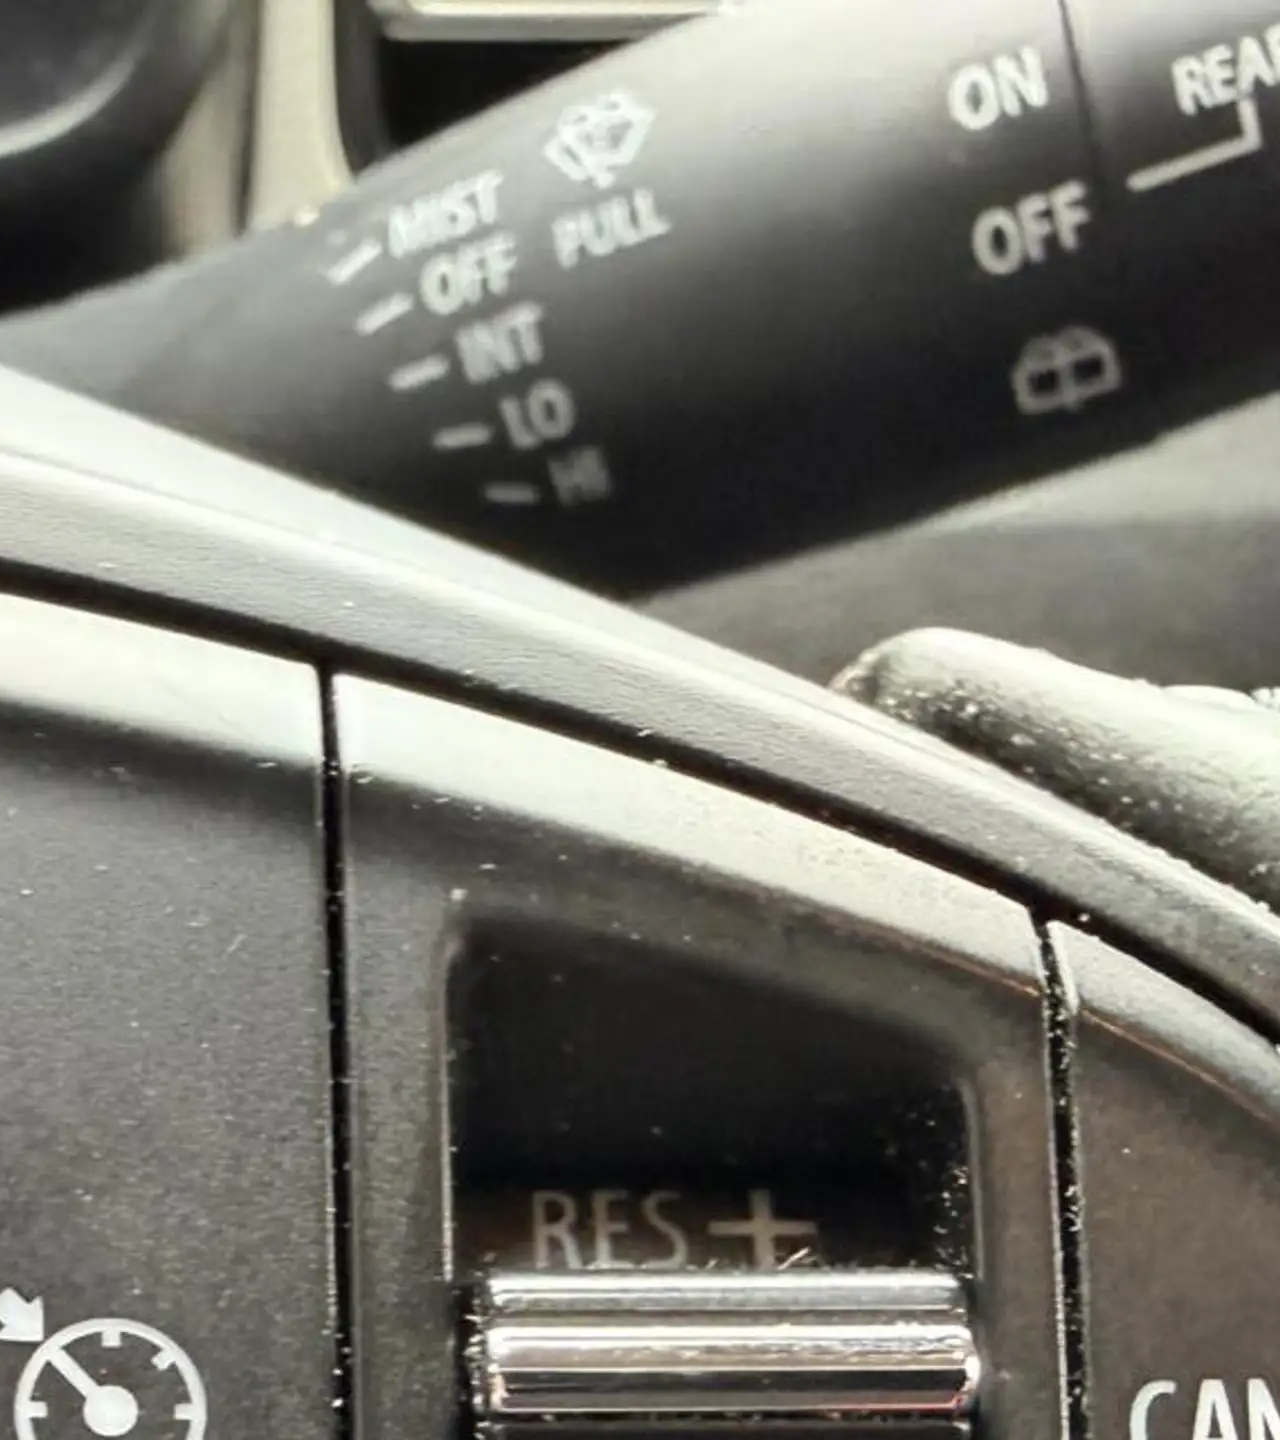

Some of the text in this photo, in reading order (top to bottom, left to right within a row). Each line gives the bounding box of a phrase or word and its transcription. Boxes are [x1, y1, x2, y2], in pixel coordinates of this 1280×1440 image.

[948, 46, 1048, 131] ON
[388, 168, 504, 258] MIST
[552, 187, 672, 269] PULL
[971, 179, 1091, 275] OFF
[422, 231, 518, 315] OFF
[455, 301, 544, 384] INT
[499, 379, 576, 449] LO
[531, 1190, 687, 1269] RES
